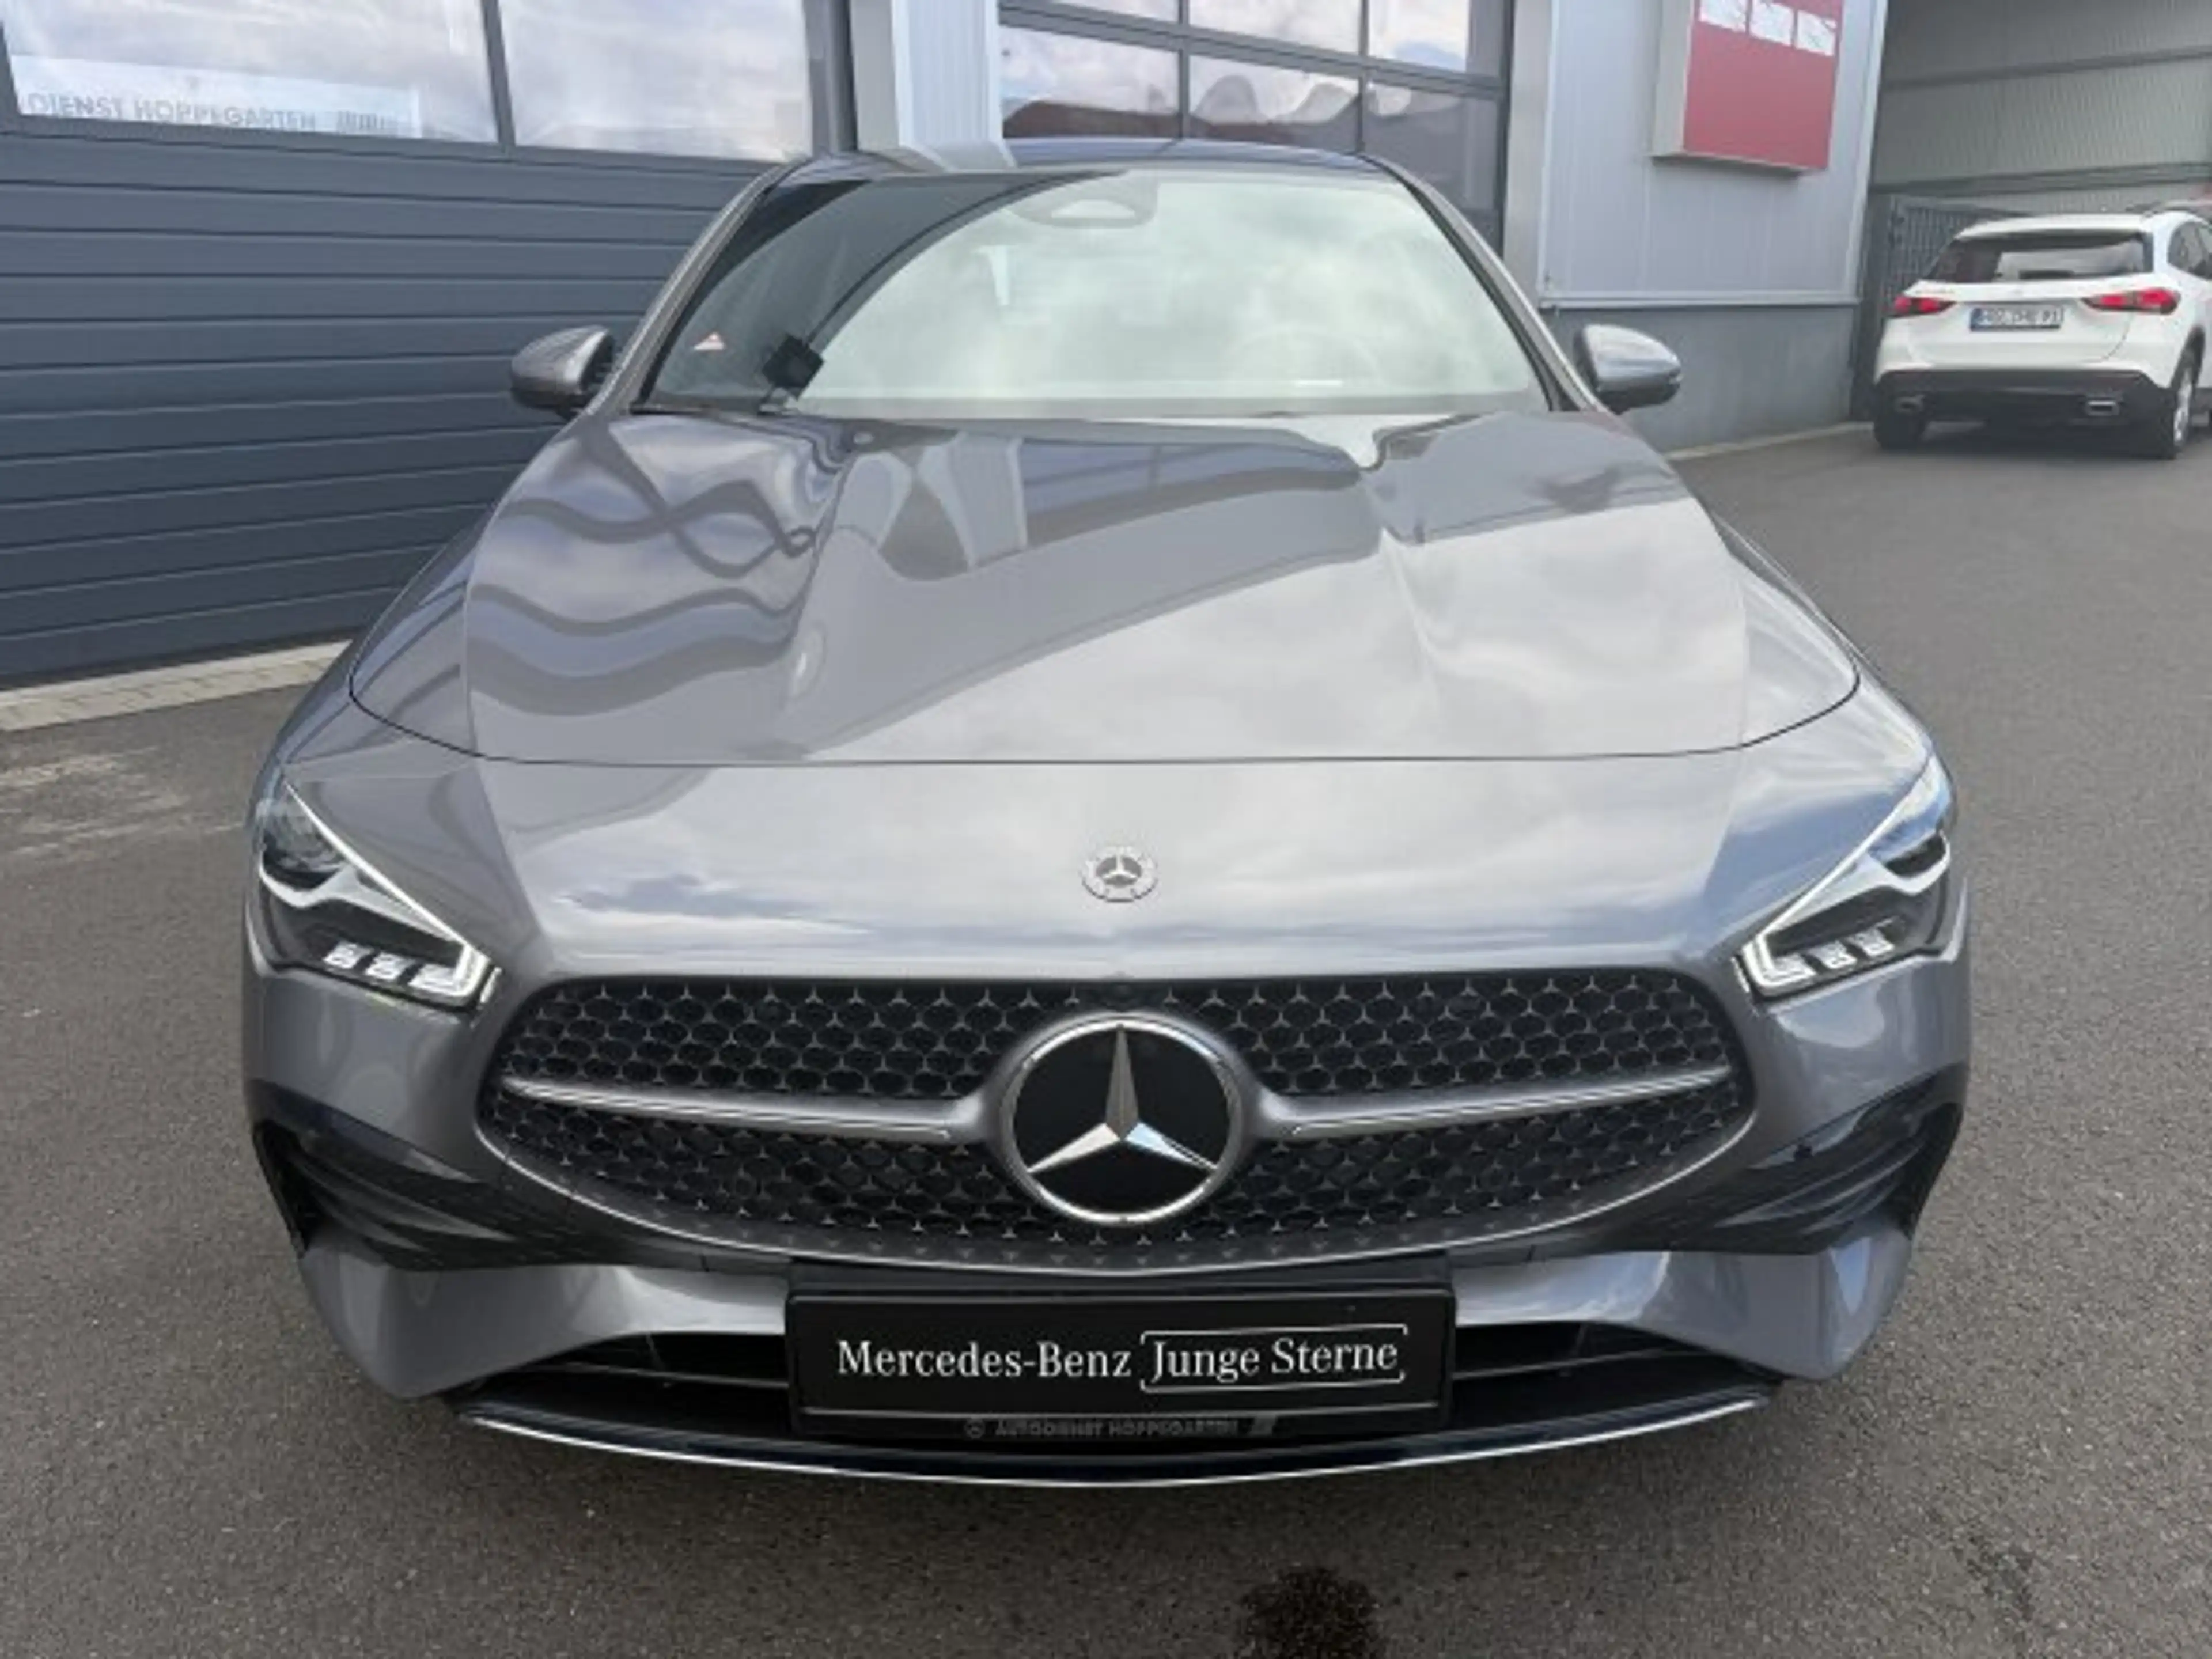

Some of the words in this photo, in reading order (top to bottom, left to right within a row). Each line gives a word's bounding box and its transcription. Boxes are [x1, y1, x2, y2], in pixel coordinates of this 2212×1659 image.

[838, 1339, 1132, 1377] Mercedes-Benz
[1152, 1340, 1260, 1383] Junge
[1271, 1336, 1398, 1374] Sterne
